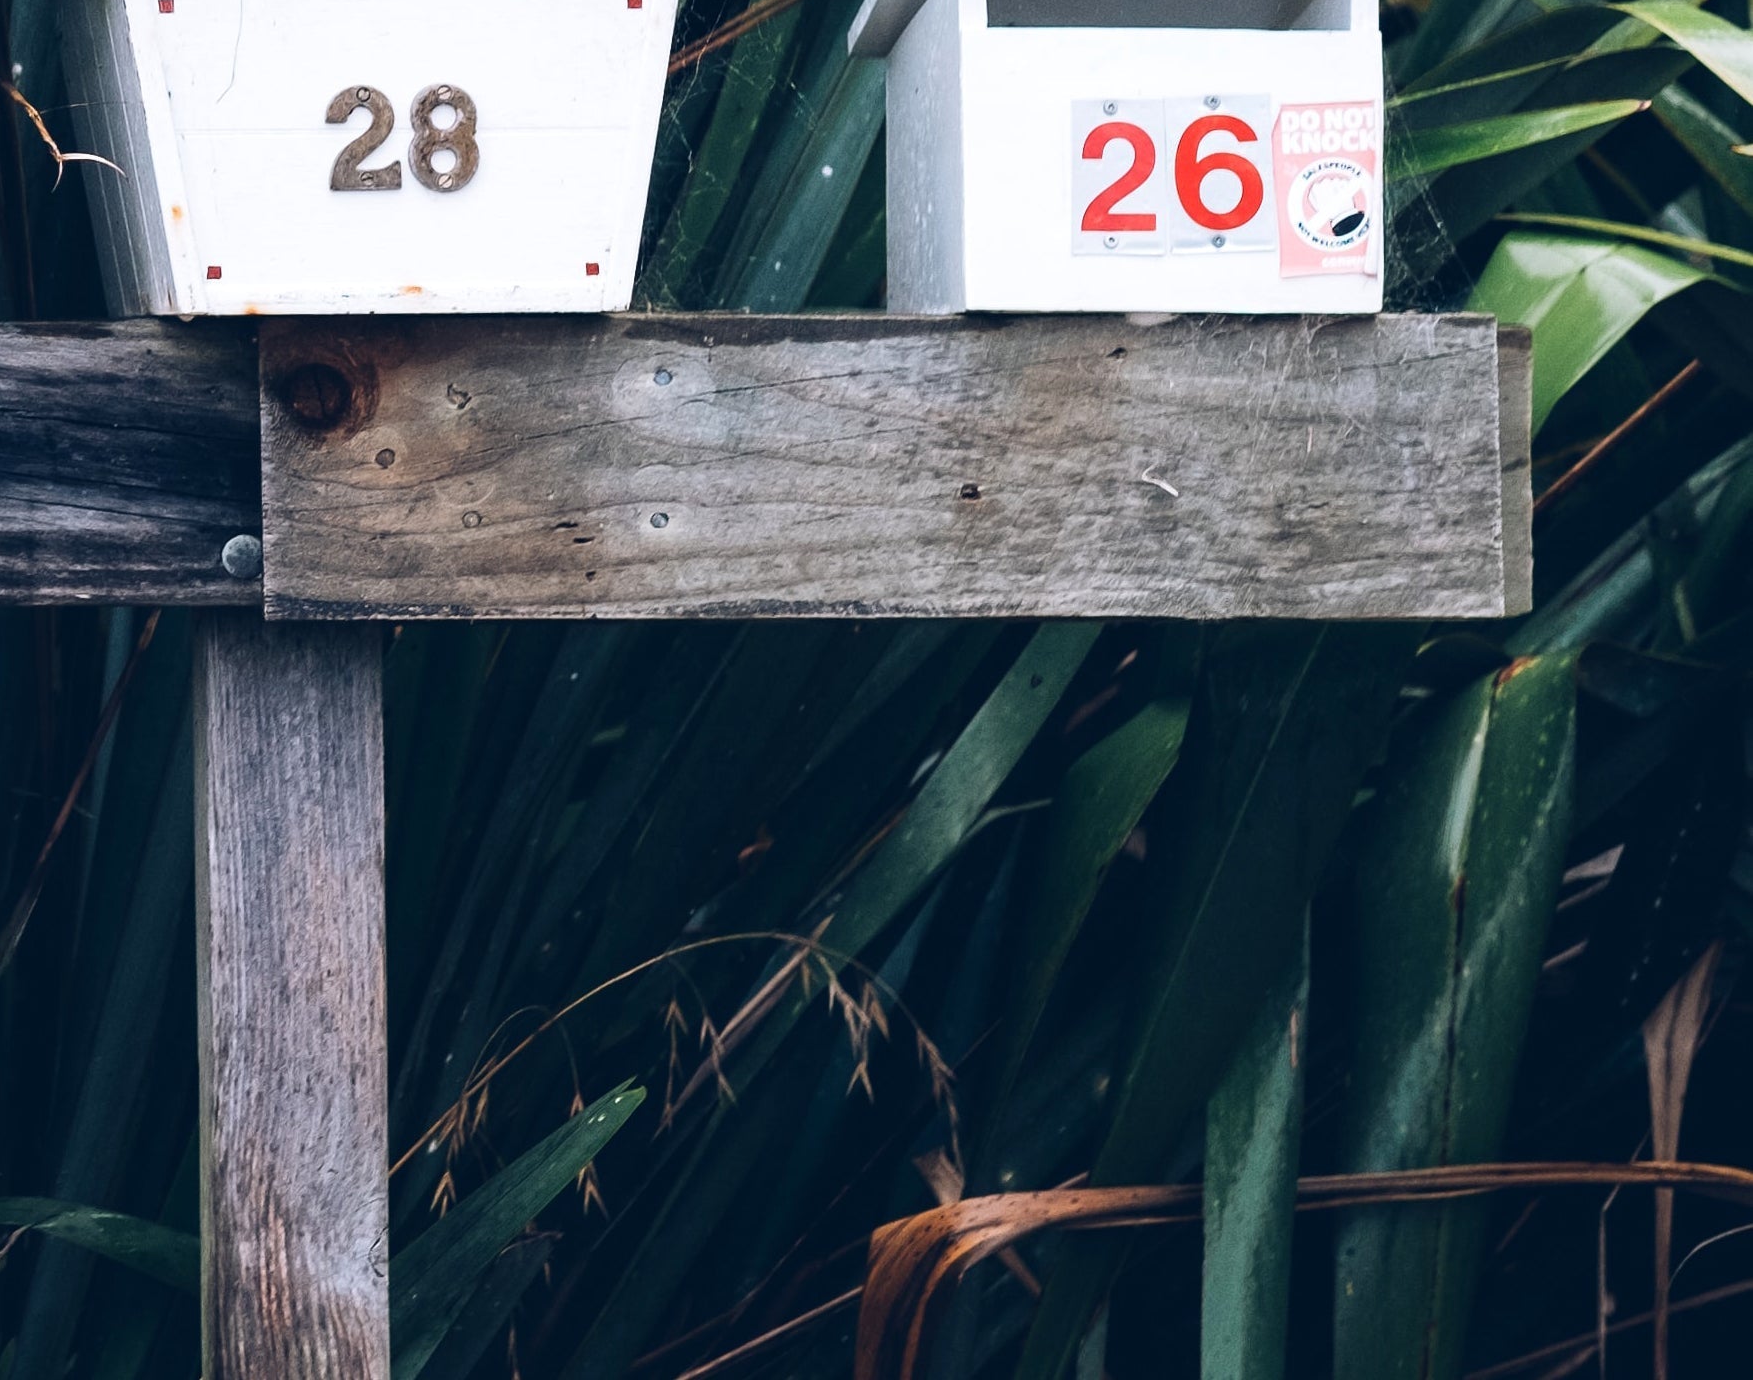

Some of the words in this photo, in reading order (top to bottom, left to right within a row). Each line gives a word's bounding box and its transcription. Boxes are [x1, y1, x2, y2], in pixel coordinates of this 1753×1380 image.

[325, 84, 480, 192] 28
[1281, 109, 1320, 132] DO
[1281, 128, 1375, 155] KNOCK
[1080, 114, 1265, 232] 26
